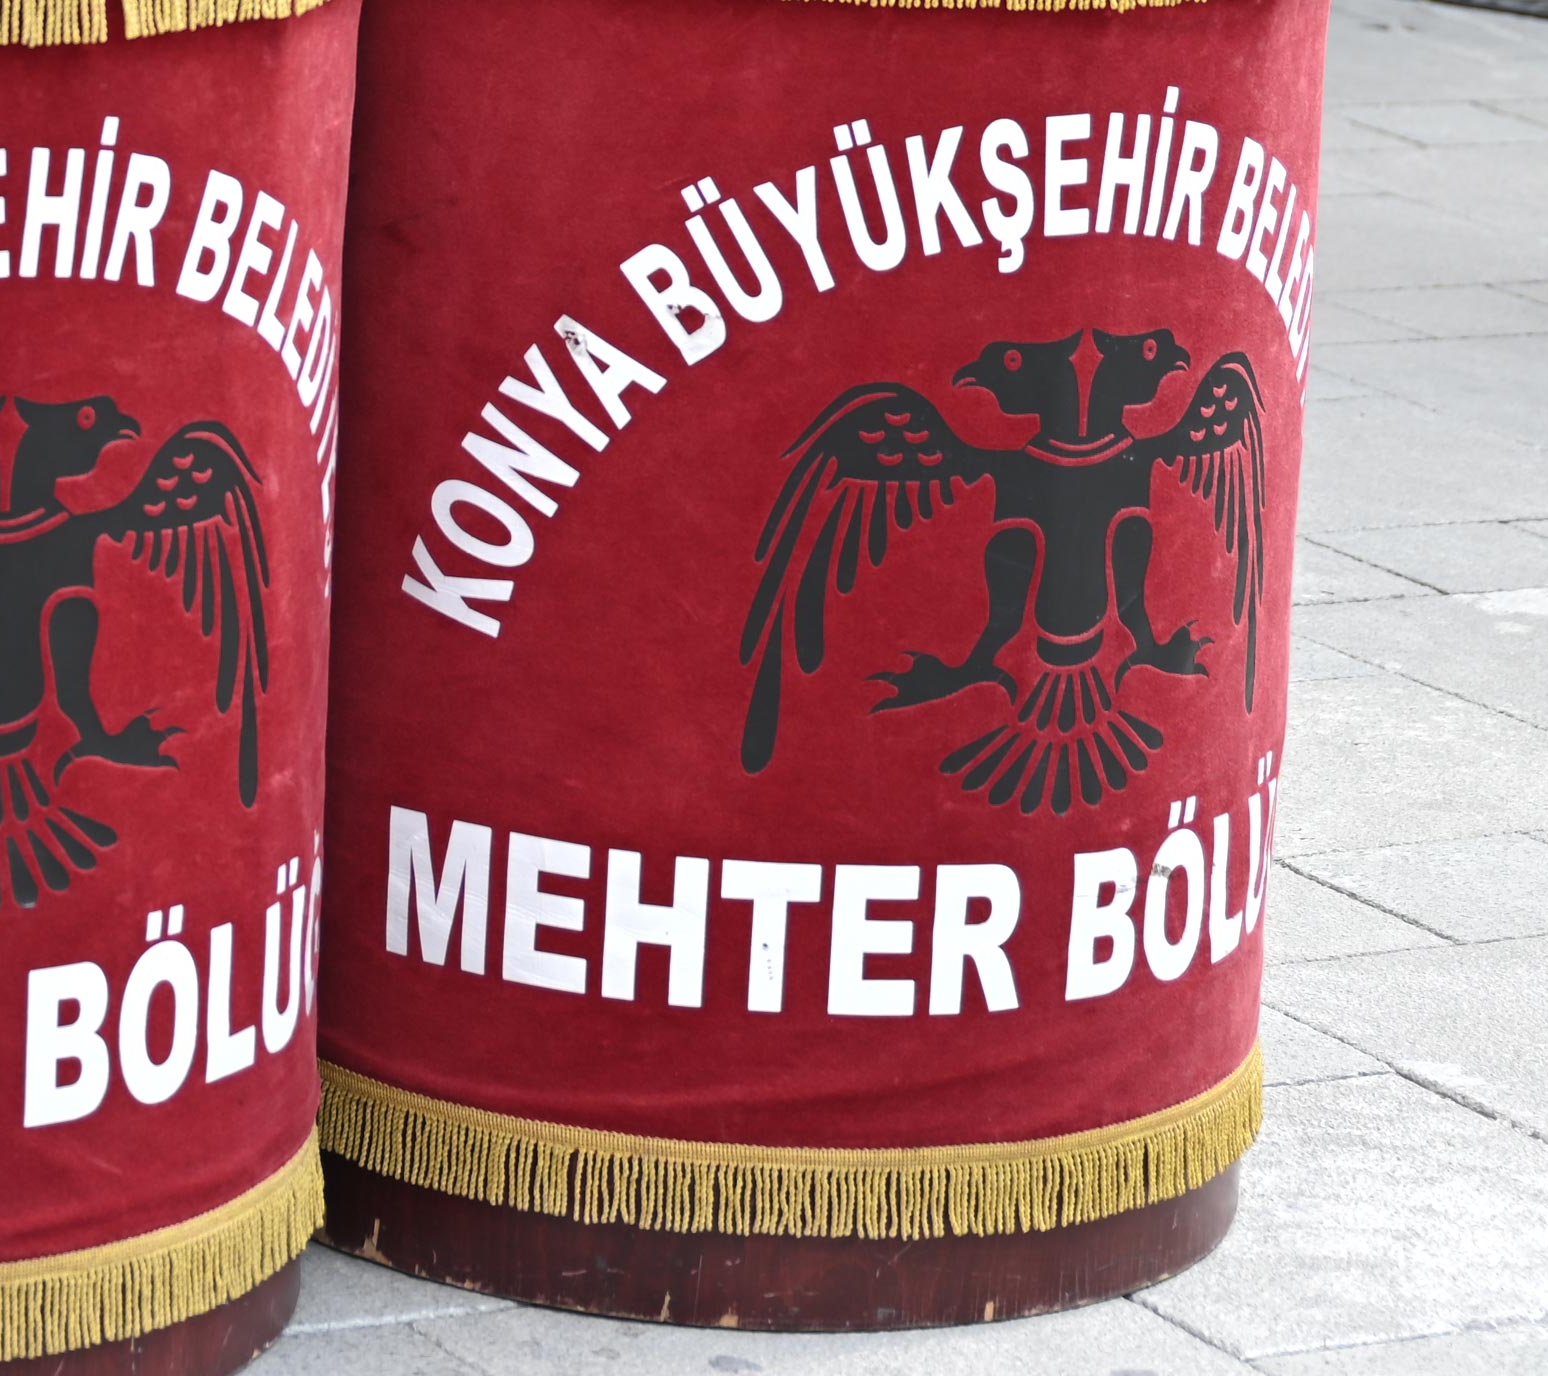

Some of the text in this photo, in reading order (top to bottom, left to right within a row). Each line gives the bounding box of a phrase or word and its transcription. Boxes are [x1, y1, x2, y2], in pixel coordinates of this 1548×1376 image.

[176, 170, 340, 598] BELEDİ
[402, 86, 1315, 637] KONYA BÜYÜKŞEHİR BELED
[386, 751, 1278, 1016] MEHTER BÖLÜ
